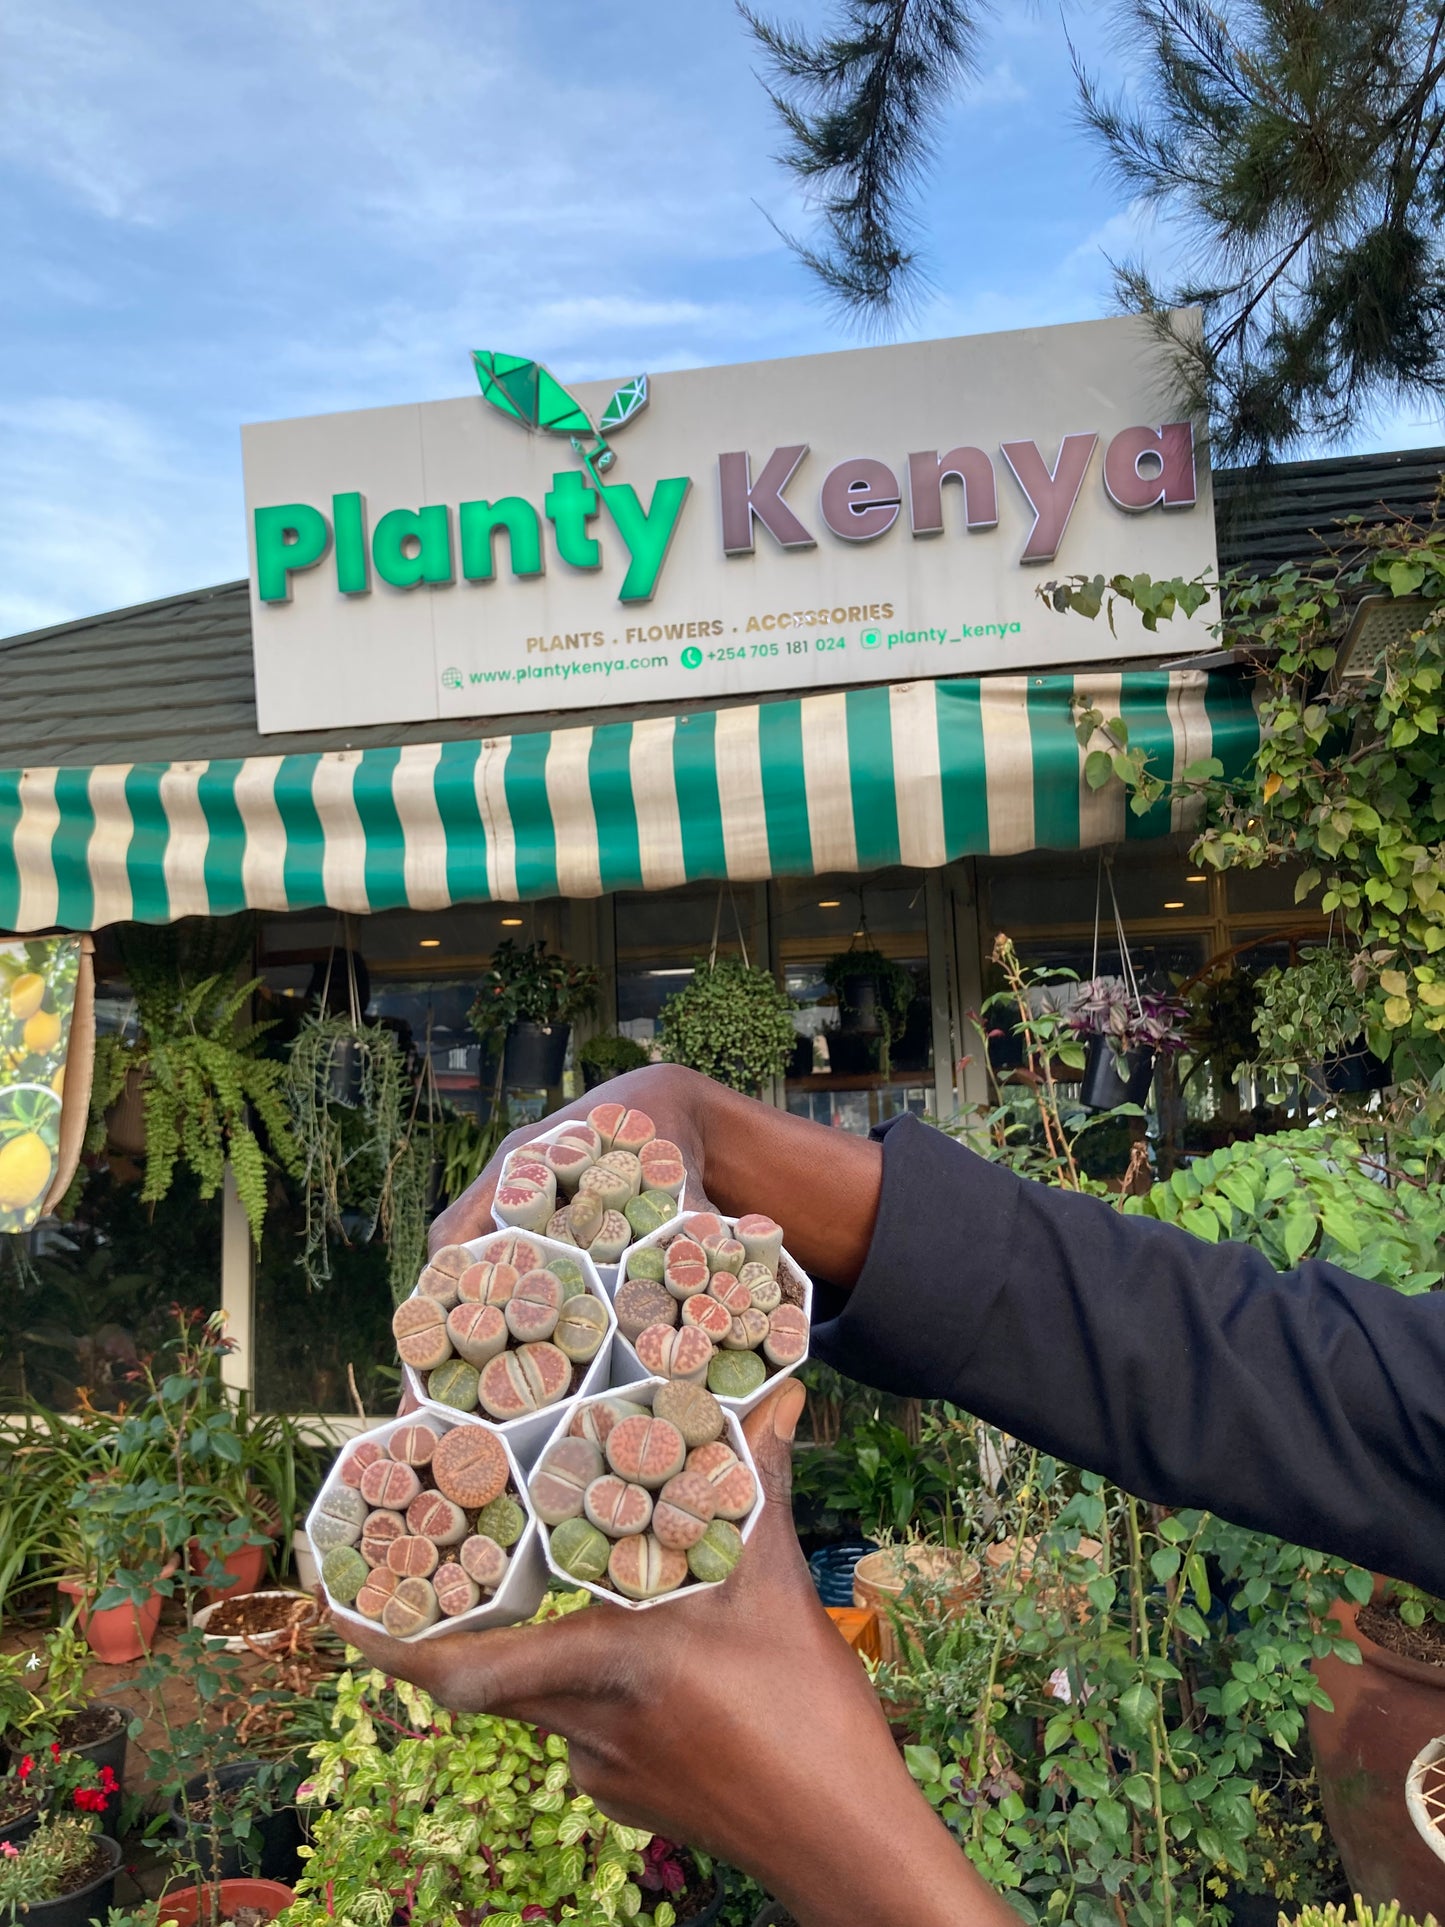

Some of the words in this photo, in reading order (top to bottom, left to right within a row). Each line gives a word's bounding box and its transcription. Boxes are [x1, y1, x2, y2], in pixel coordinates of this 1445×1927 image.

[254, 471, 693, 604] Planty
[718, 421, 1197, 566] Kenya
[469, 654, 668, 684] www.plantykenya.com
[707, 647, 746, 661] +254
[750, 643, 779, 658] 705
[785, 640, 808, 655] 181
[815, 636, 846, 651] 024
[887, 621, 1022, 650] planty_kenya
[526, 631, 605, 653] PLANTS
[625, 619, 724, 643] FLOWERS
[745, 602, 895, 633] ACCESSORIES
